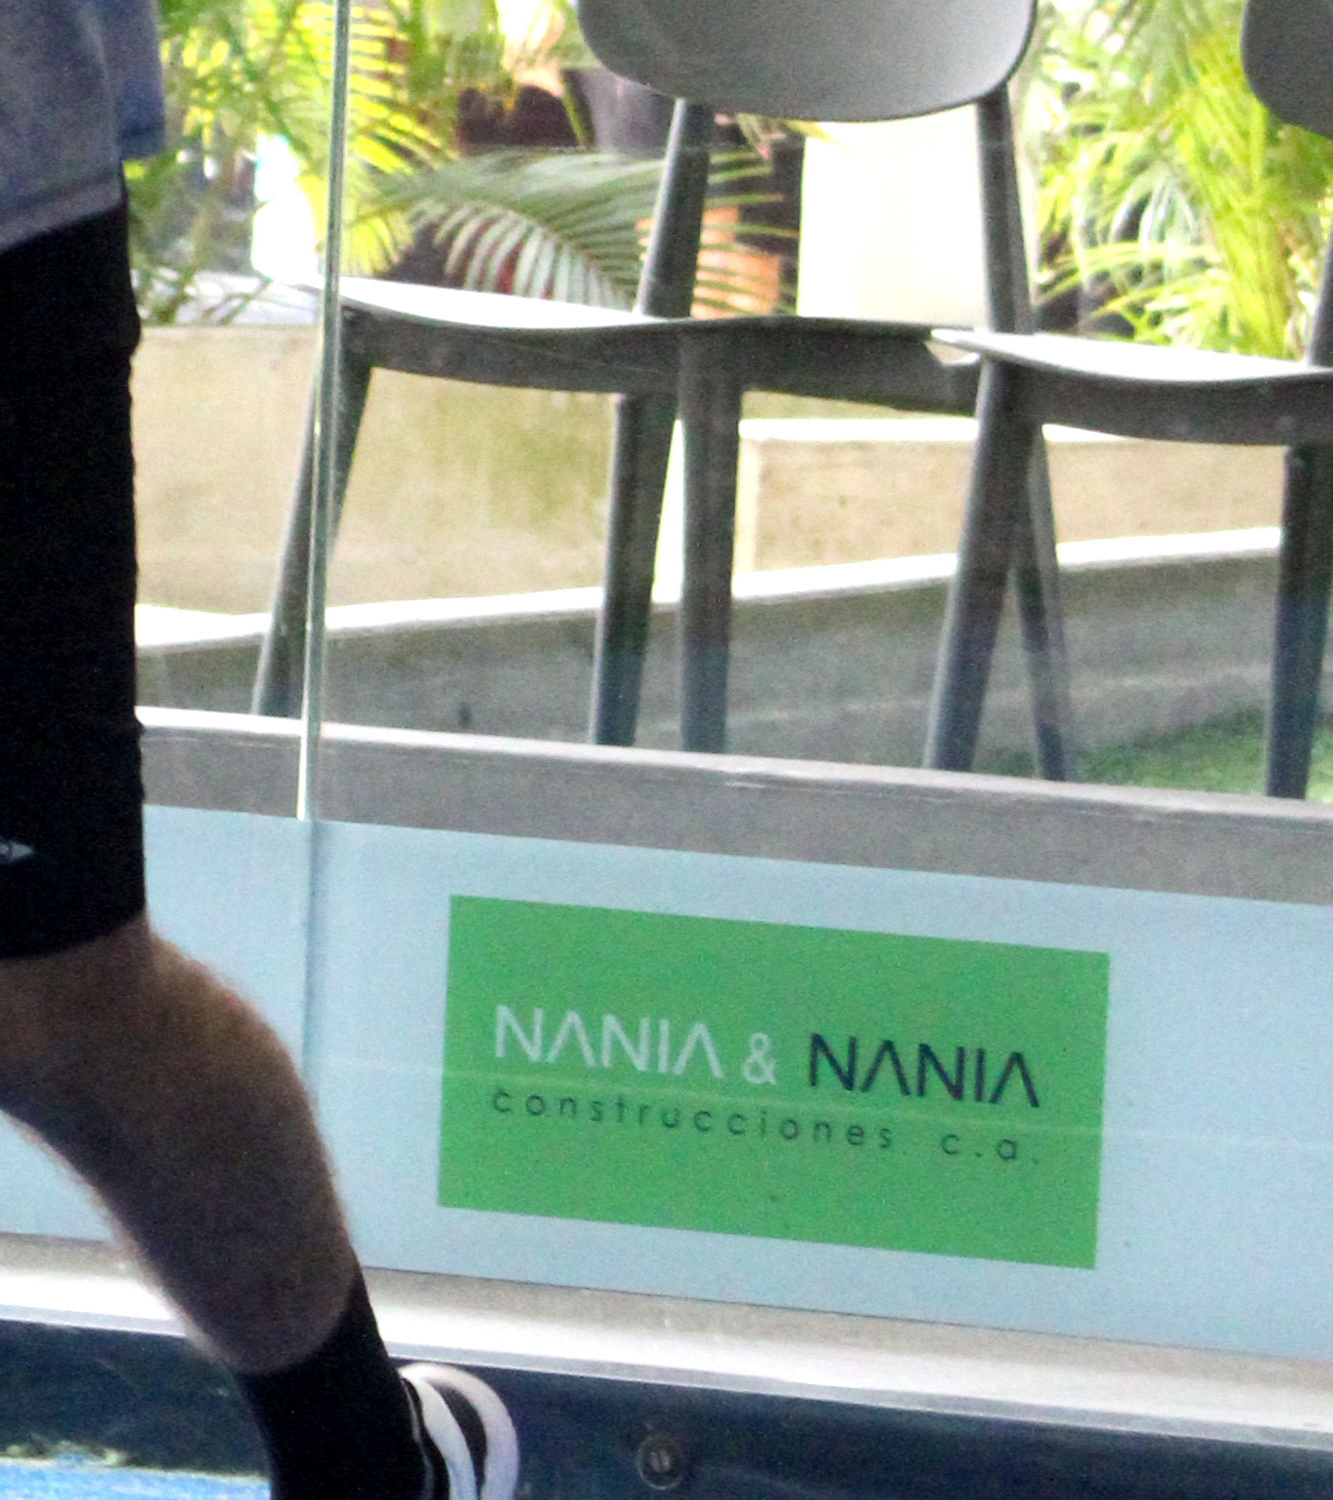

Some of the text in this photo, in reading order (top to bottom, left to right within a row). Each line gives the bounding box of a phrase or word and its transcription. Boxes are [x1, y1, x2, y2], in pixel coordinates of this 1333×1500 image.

[493, 1004, 1041, 1108] NANIA & NANIA
[492, 1087, 894, 1150] construcciones
